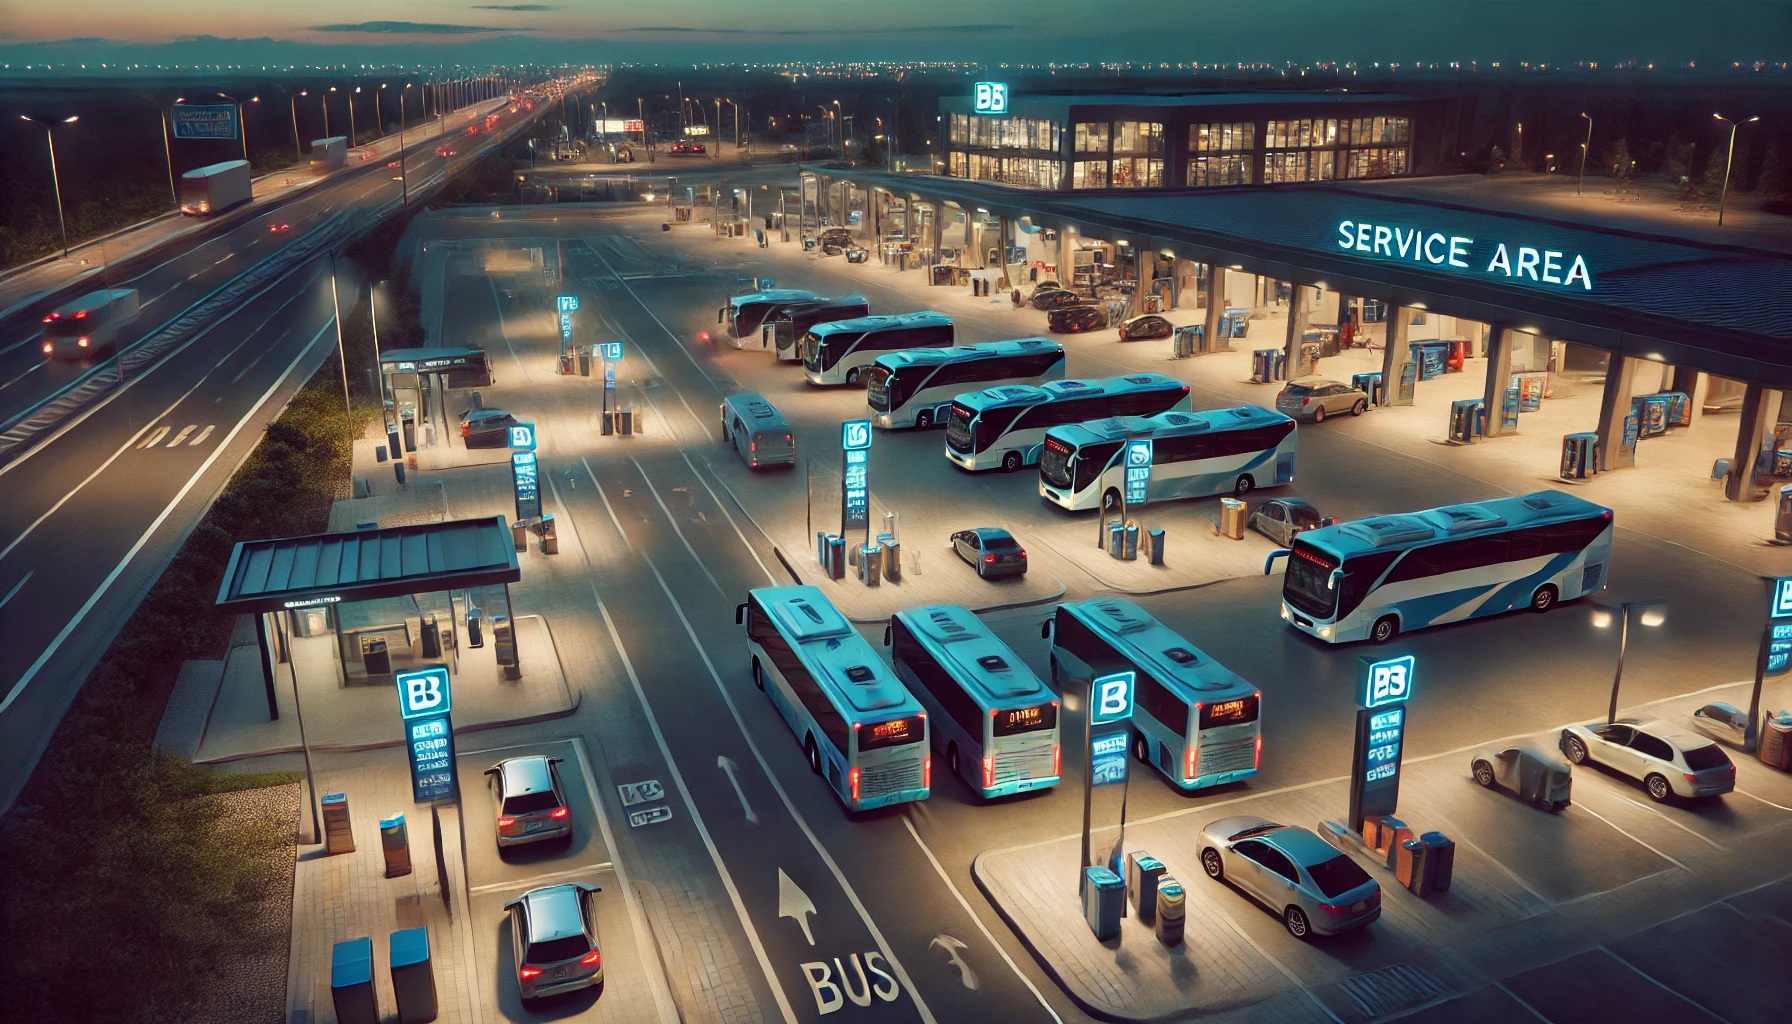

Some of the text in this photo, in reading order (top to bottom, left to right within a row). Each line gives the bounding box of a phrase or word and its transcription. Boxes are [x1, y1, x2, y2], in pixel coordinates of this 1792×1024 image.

[1338, 220, 1592, 290] SERVICE AREA
[800, 951, 900, 1015] BUS
